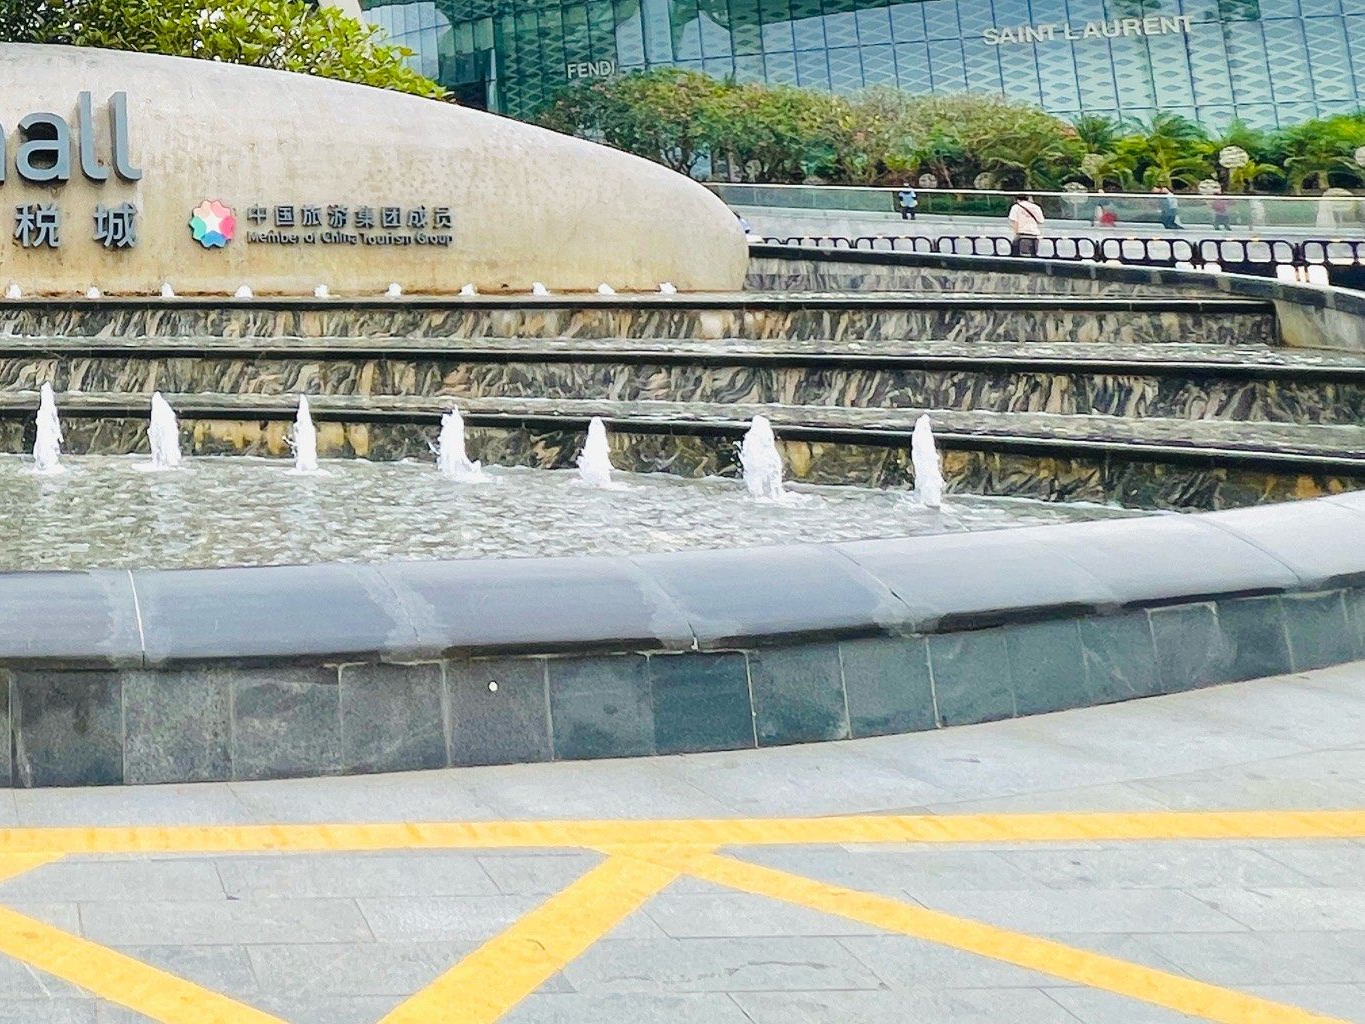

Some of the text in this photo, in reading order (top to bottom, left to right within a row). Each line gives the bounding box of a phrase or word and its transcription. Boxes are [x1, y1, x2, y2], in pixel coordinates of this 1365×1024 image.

[983, 15, 1195, 46] SAINT LAURENT
[567, 59, 615, 79] FENDI
[247, 203, 453, 229] 中国旅游集团成员
[247, 229, 453, 247] Member of China Tourism Group
